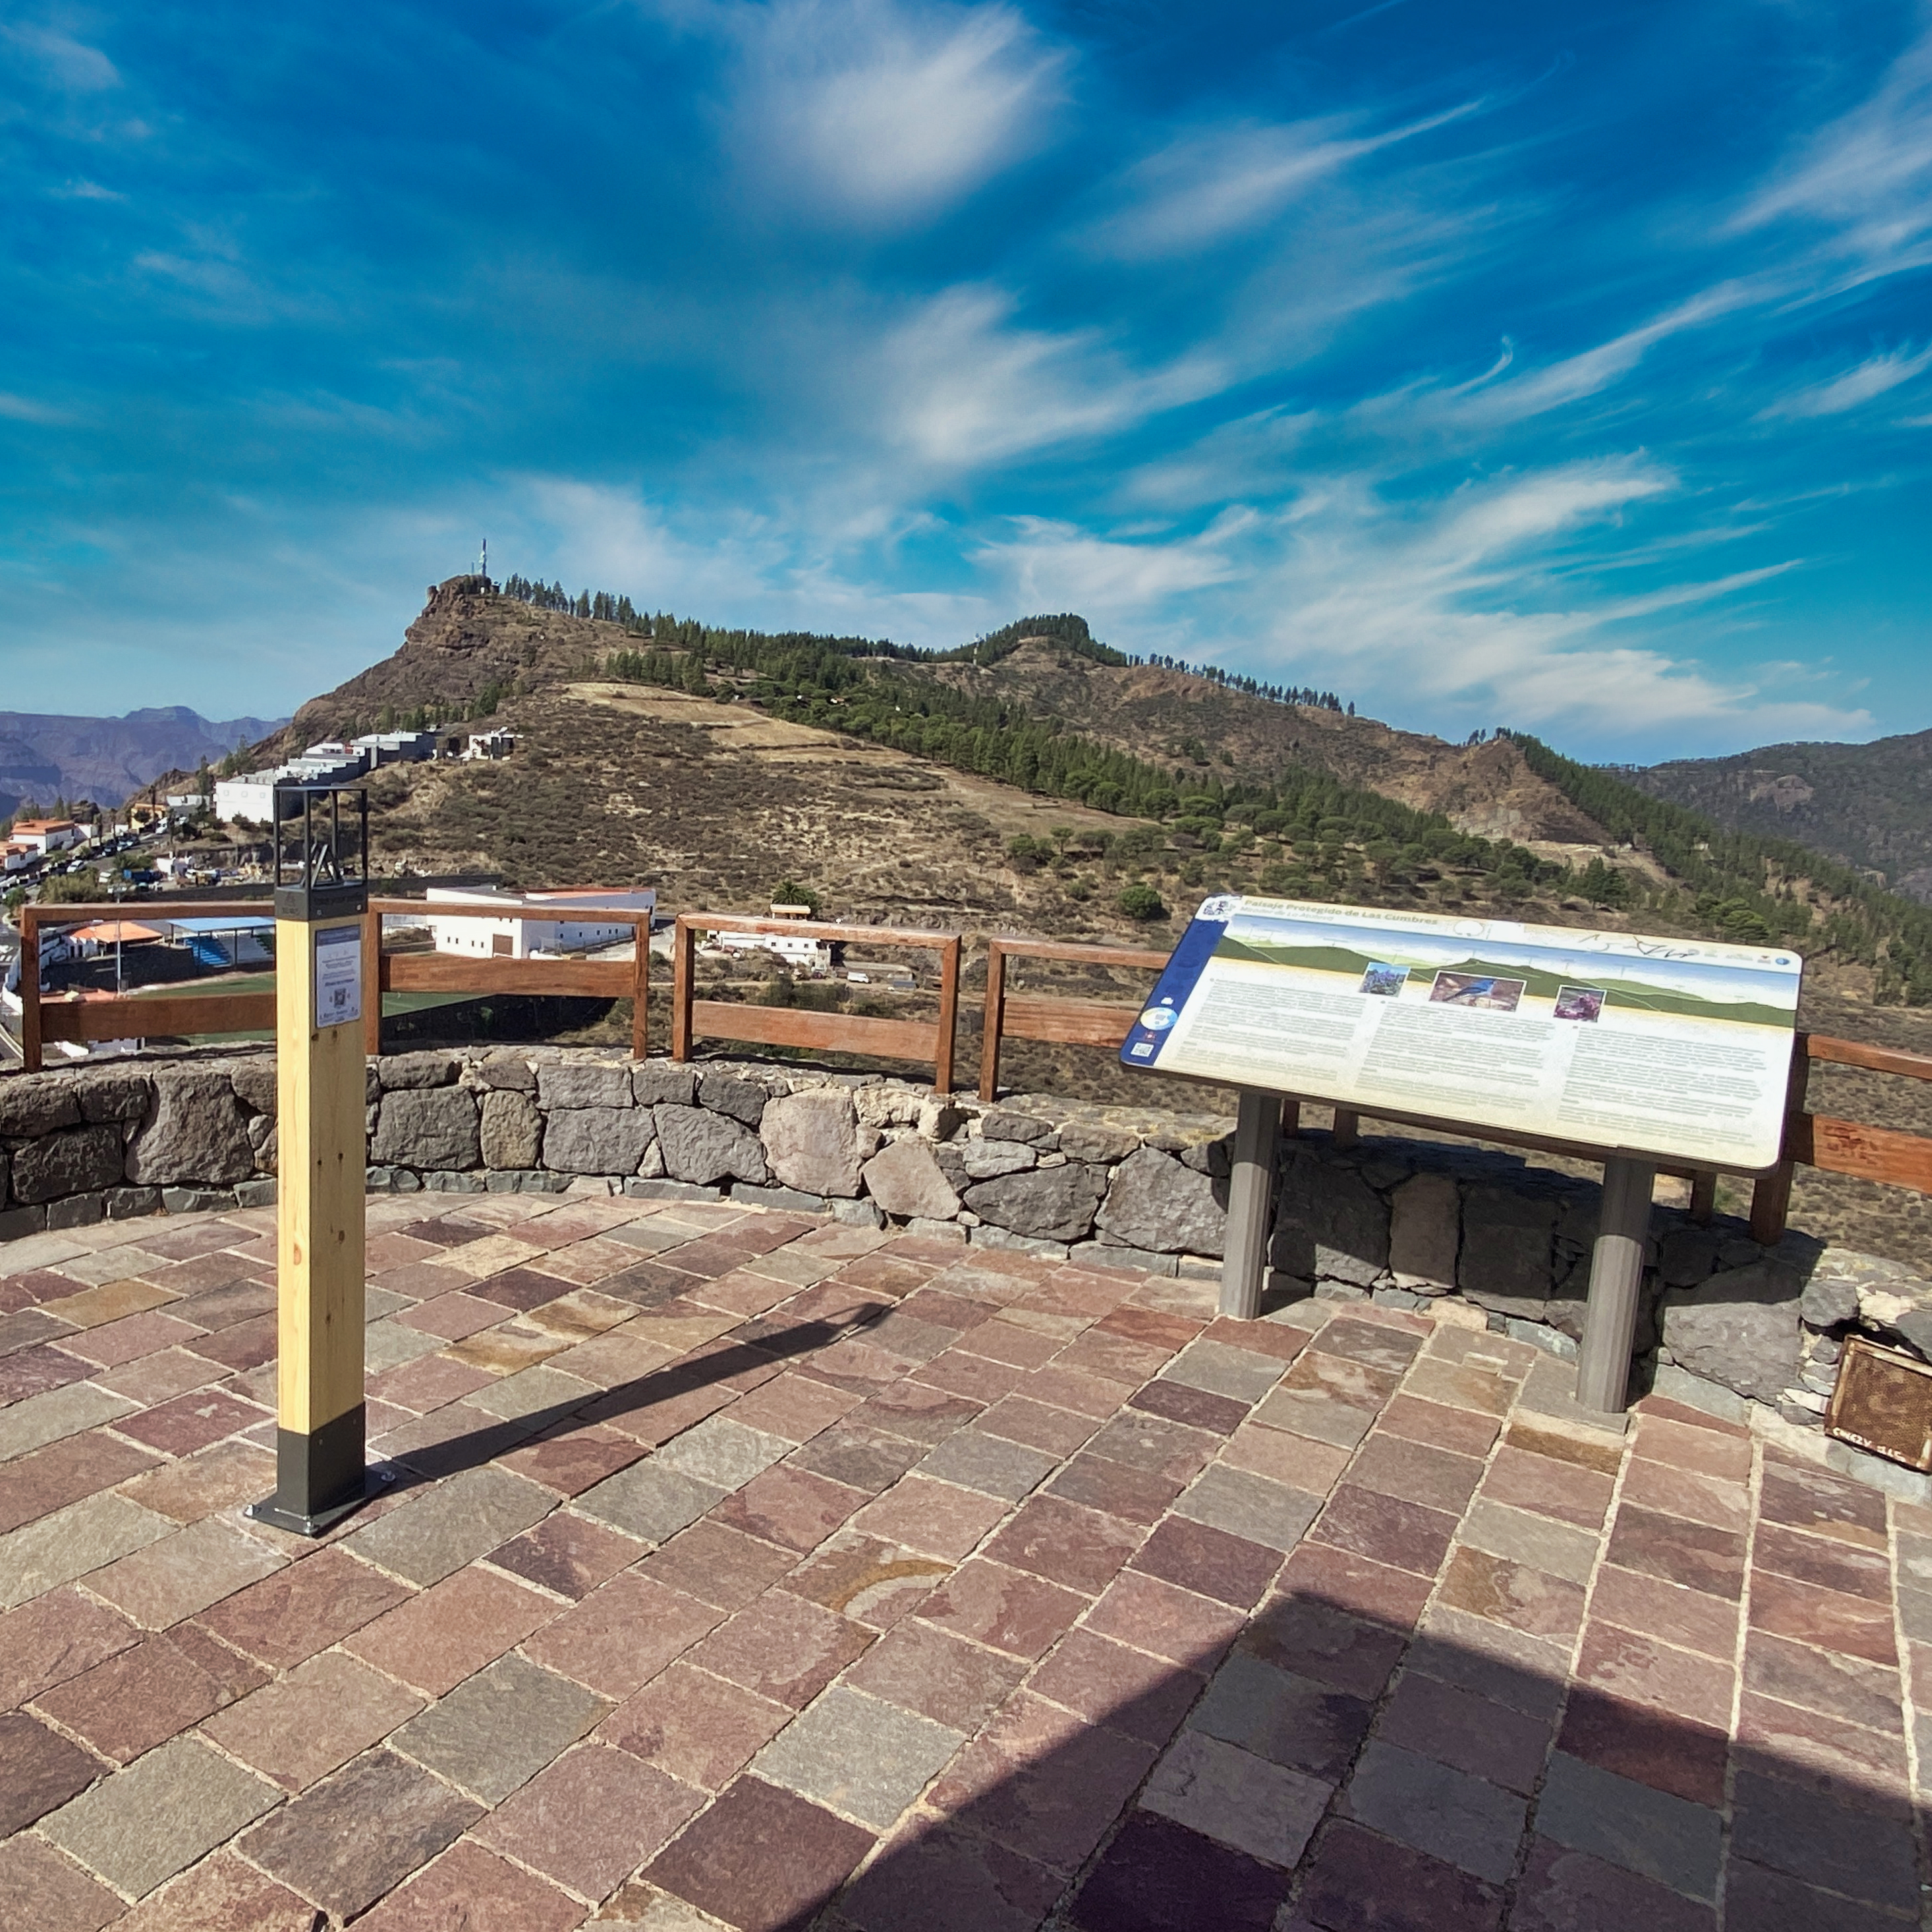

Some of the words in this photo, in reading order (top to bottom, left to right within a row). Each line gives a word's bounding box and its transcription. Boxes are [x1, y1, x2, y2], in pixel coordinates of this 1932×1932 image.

[1245, 900, 1284, 910] Paisaje
[1286, 904, 1342, 915] Protegido
[1384, 914, 1439, 925] Cumbres
